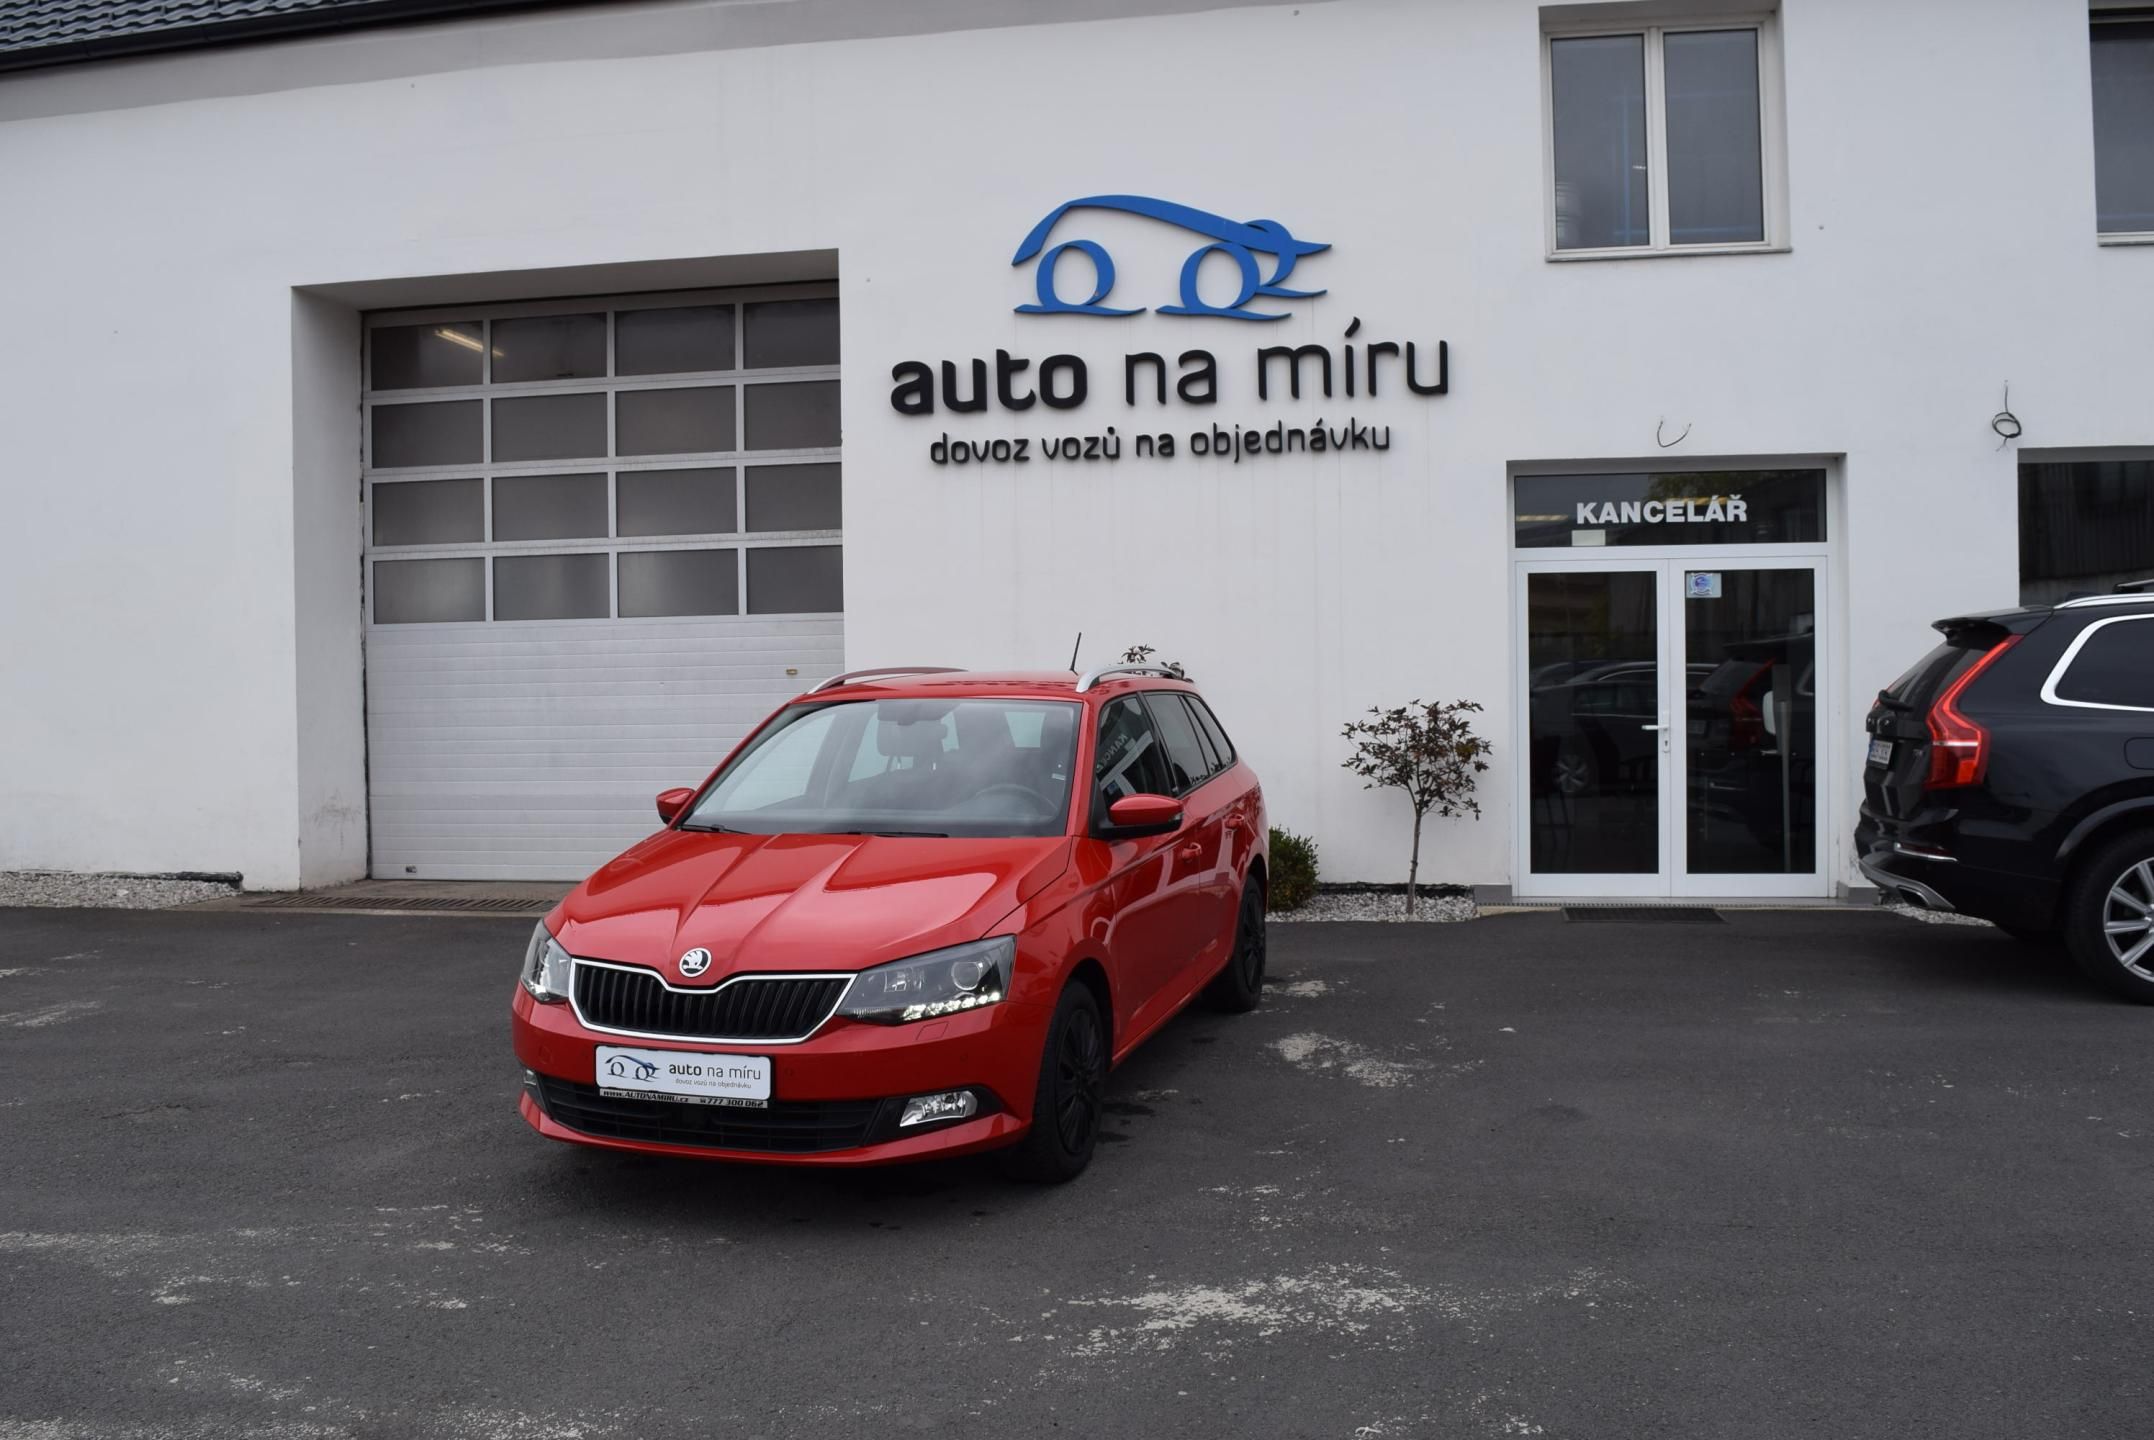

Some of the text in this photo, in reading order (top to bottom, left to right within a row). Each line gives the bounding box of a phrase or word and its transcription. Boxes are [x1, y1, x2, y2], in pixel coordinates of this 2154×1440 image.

[889, 316, 1449, 417] auto na míru
[930, 416, 1391, 467] dovoz vozů na objednávku
[1576, 494, 1748, 525] KANCELÁŘ
[668, 1063, 761, 1080] auto na míru
